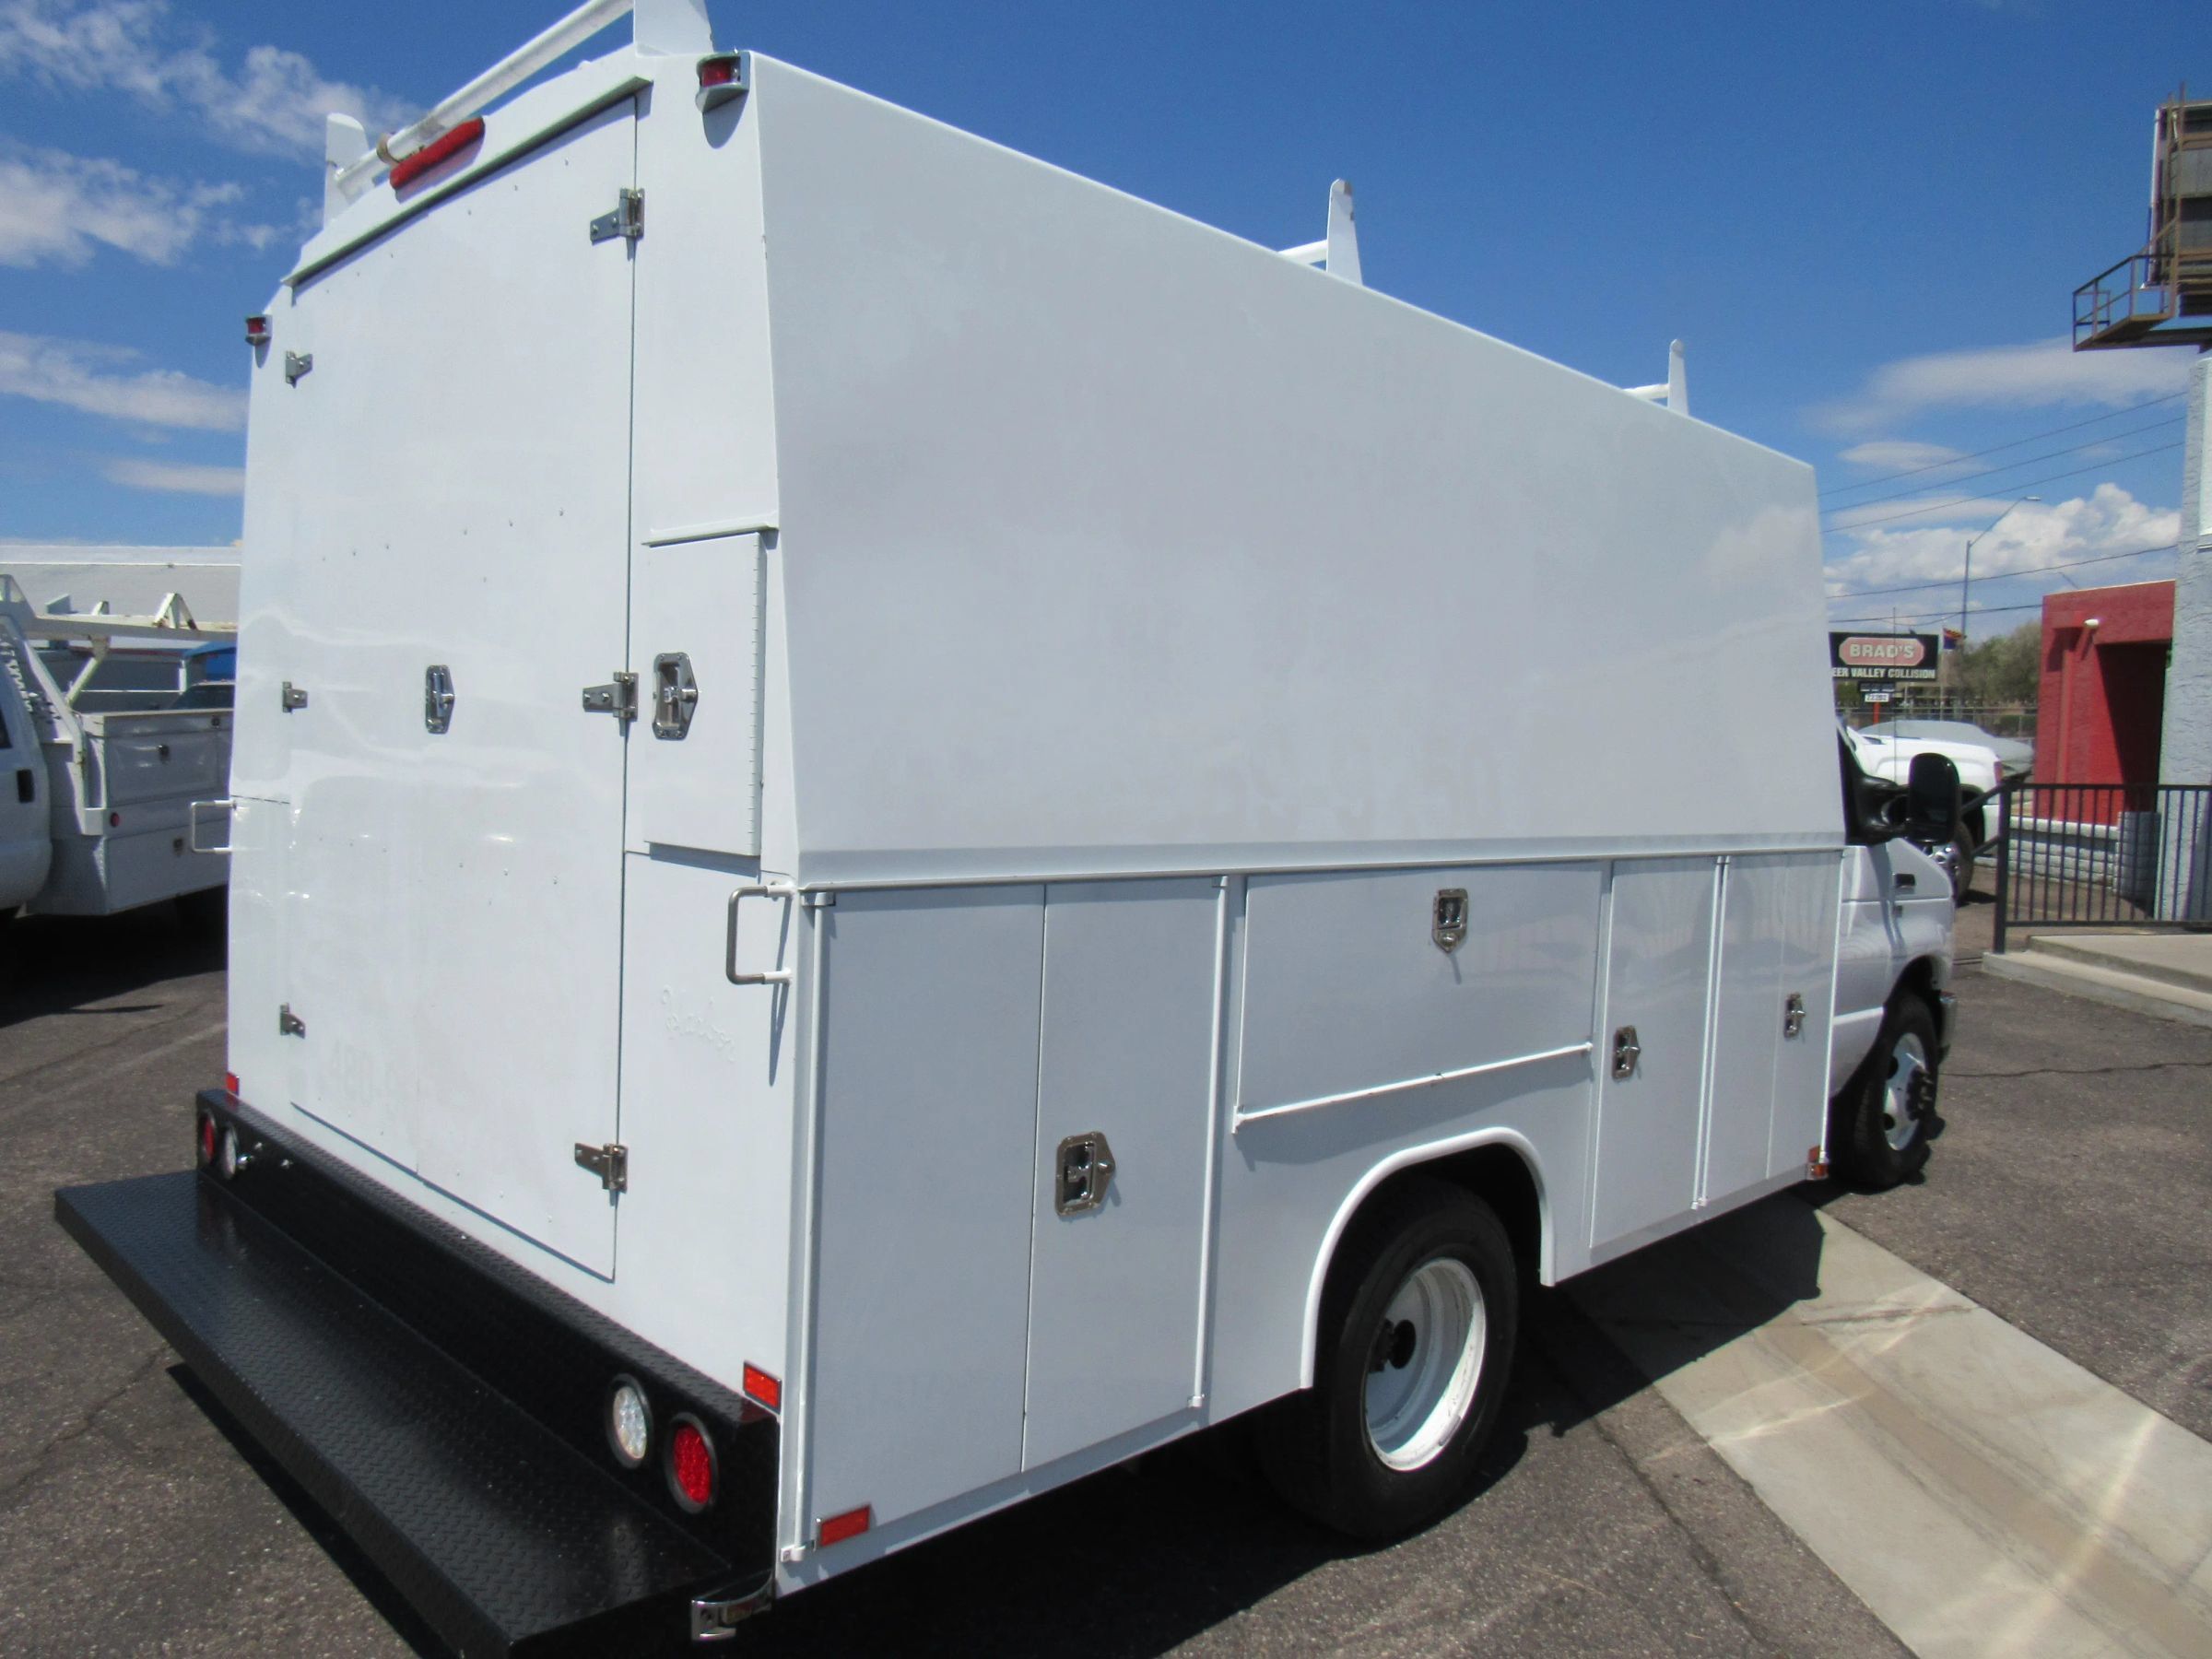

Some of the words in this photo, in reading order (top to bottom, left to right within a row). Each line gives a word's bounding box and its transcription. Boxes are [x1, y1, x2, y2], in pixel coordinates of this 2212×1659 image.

[1850, 644, 1914, 658] BRAD'S
[1851, 668, 1886, 678] VALLEY
[1888, 669, 1936, 679] COLLISION
